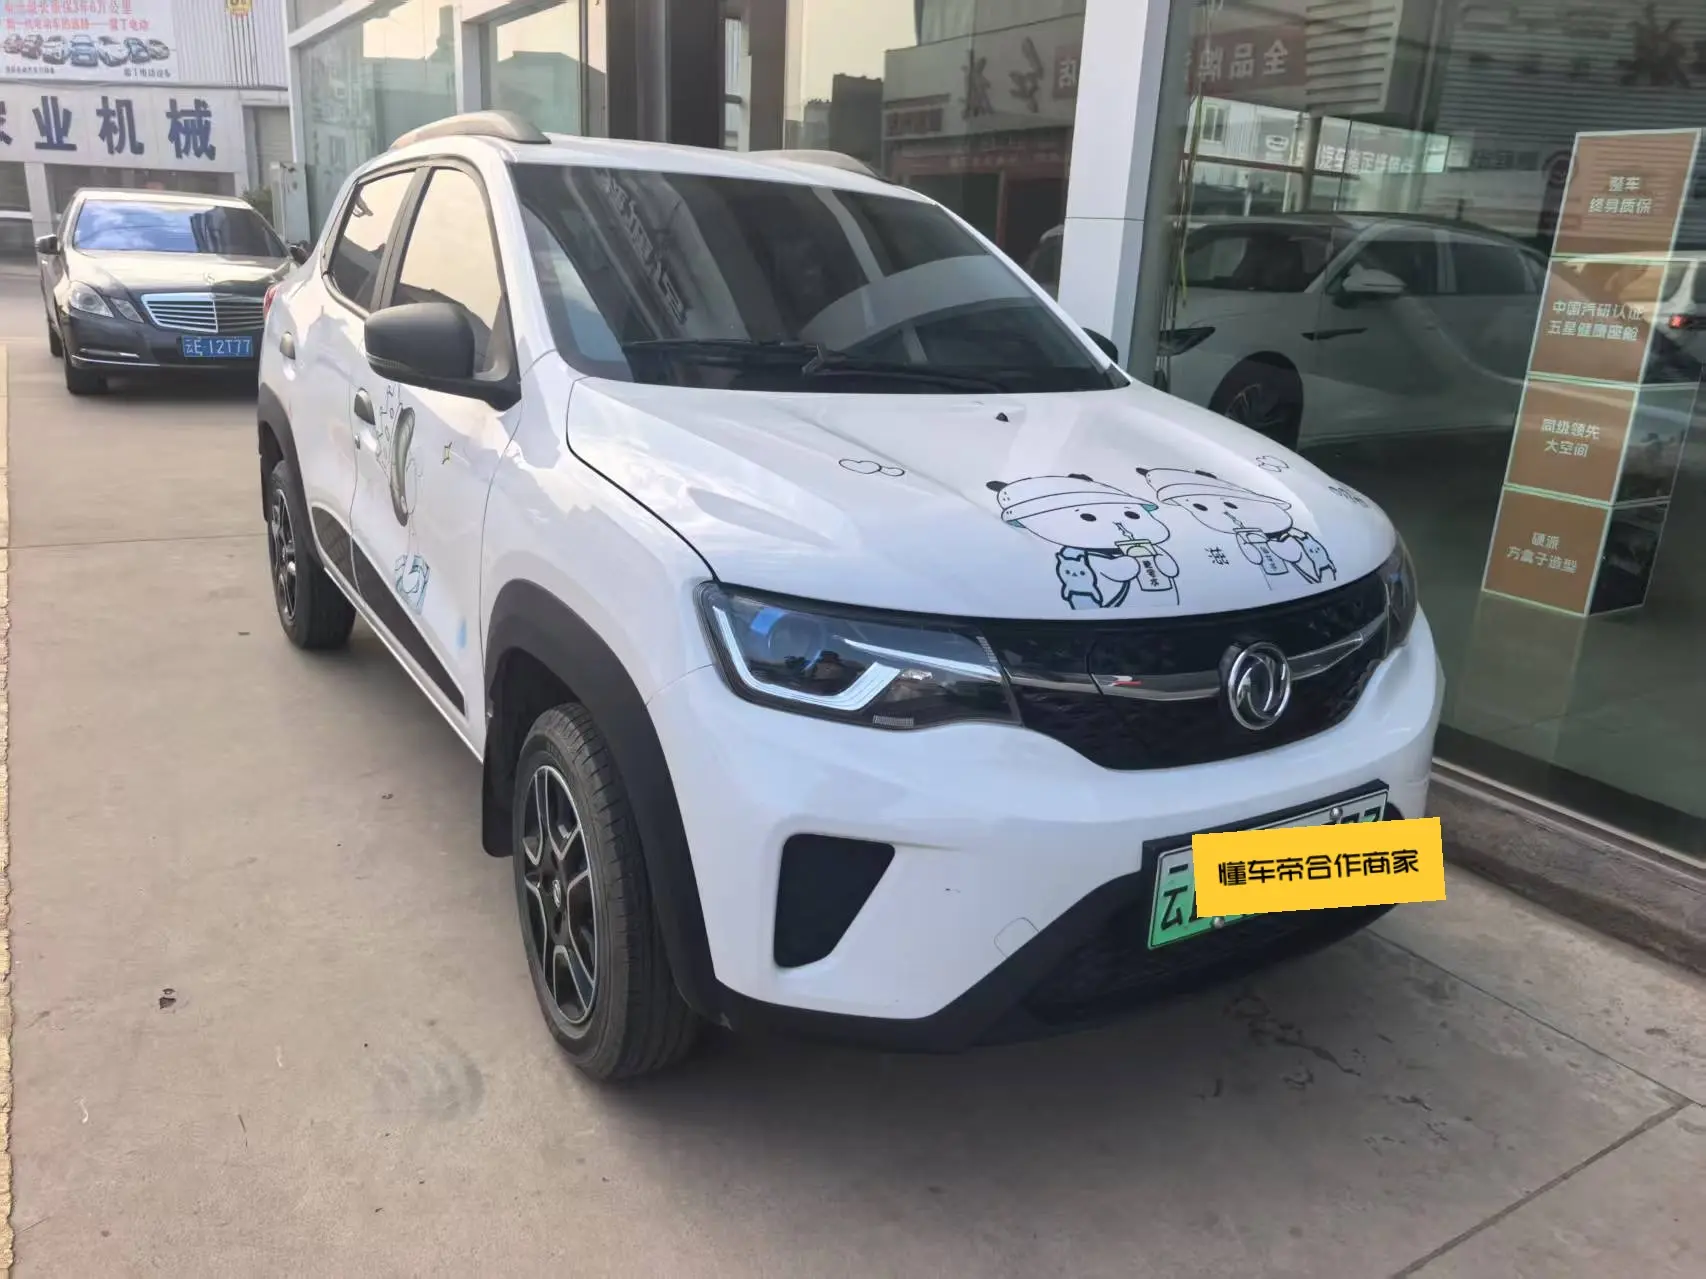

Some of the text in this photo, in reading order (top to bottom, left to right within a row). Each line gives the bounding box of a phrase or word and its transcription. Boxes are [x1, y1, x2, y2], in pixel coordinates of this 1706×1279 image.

[1608, 176, 1641, 192] 整车
[1588, 197, 1653, 214] 终身质保
[1552, 300, 1643, 320] 中国汽研认证
[1547, 320, 1639, 341] 五星健康座舱
[1540, 418, 1600, 440] 同级领先
[1544, 438, 1589, 457] 大空间
[1531, 531, 1560, 550] 硬派
[1507, 546, 1578, 573] 方盒子造型
